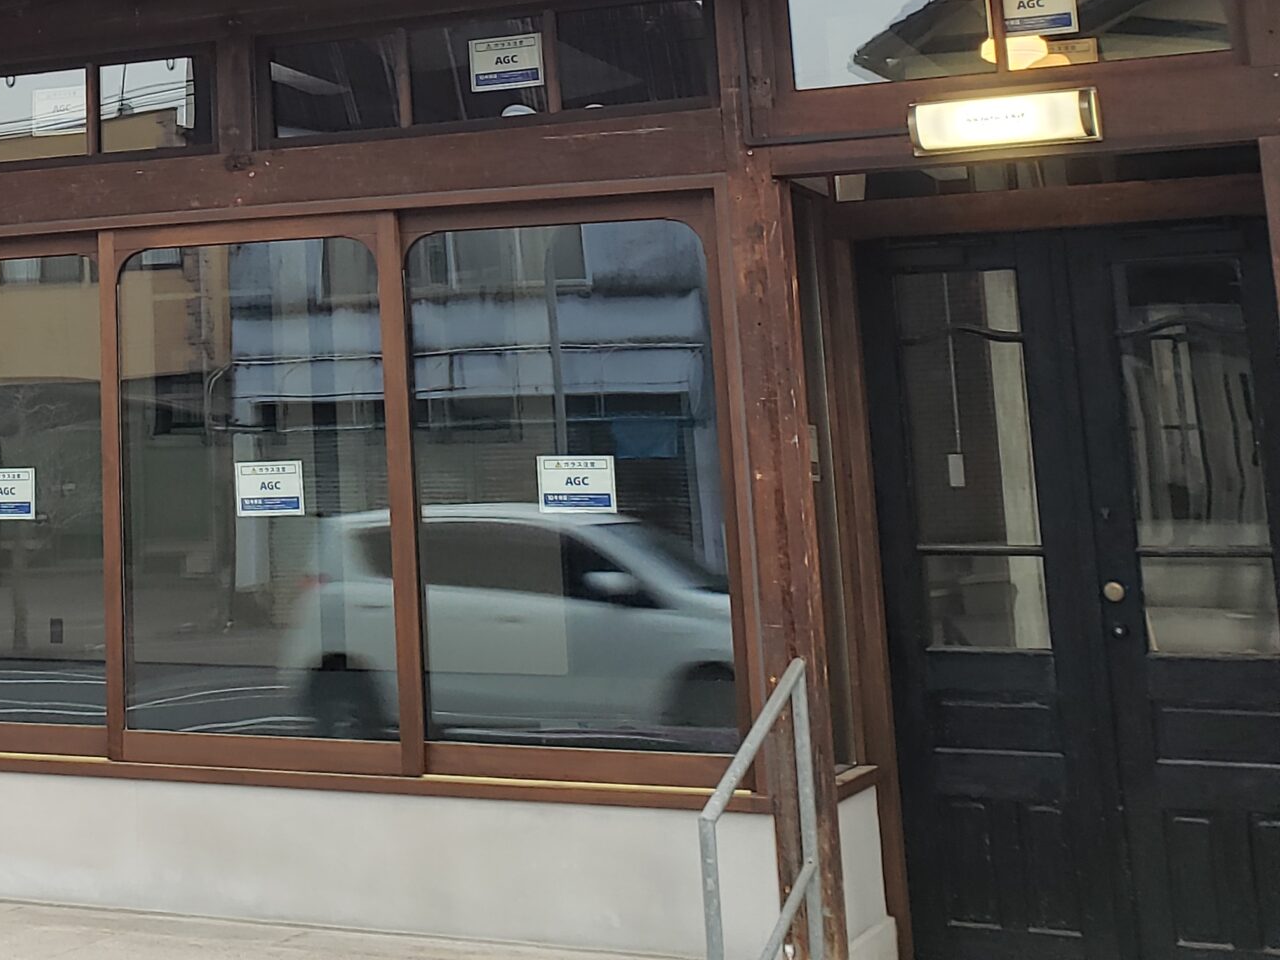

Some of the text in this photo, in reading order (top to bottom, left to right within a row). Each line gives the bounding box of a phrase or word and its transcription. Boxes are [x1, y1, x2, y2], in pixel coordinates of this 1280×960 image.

[495, 54, 519, 66] AGC
[260, 481, 281, 491] AGC
[565, 476, 590, 486] AGC
